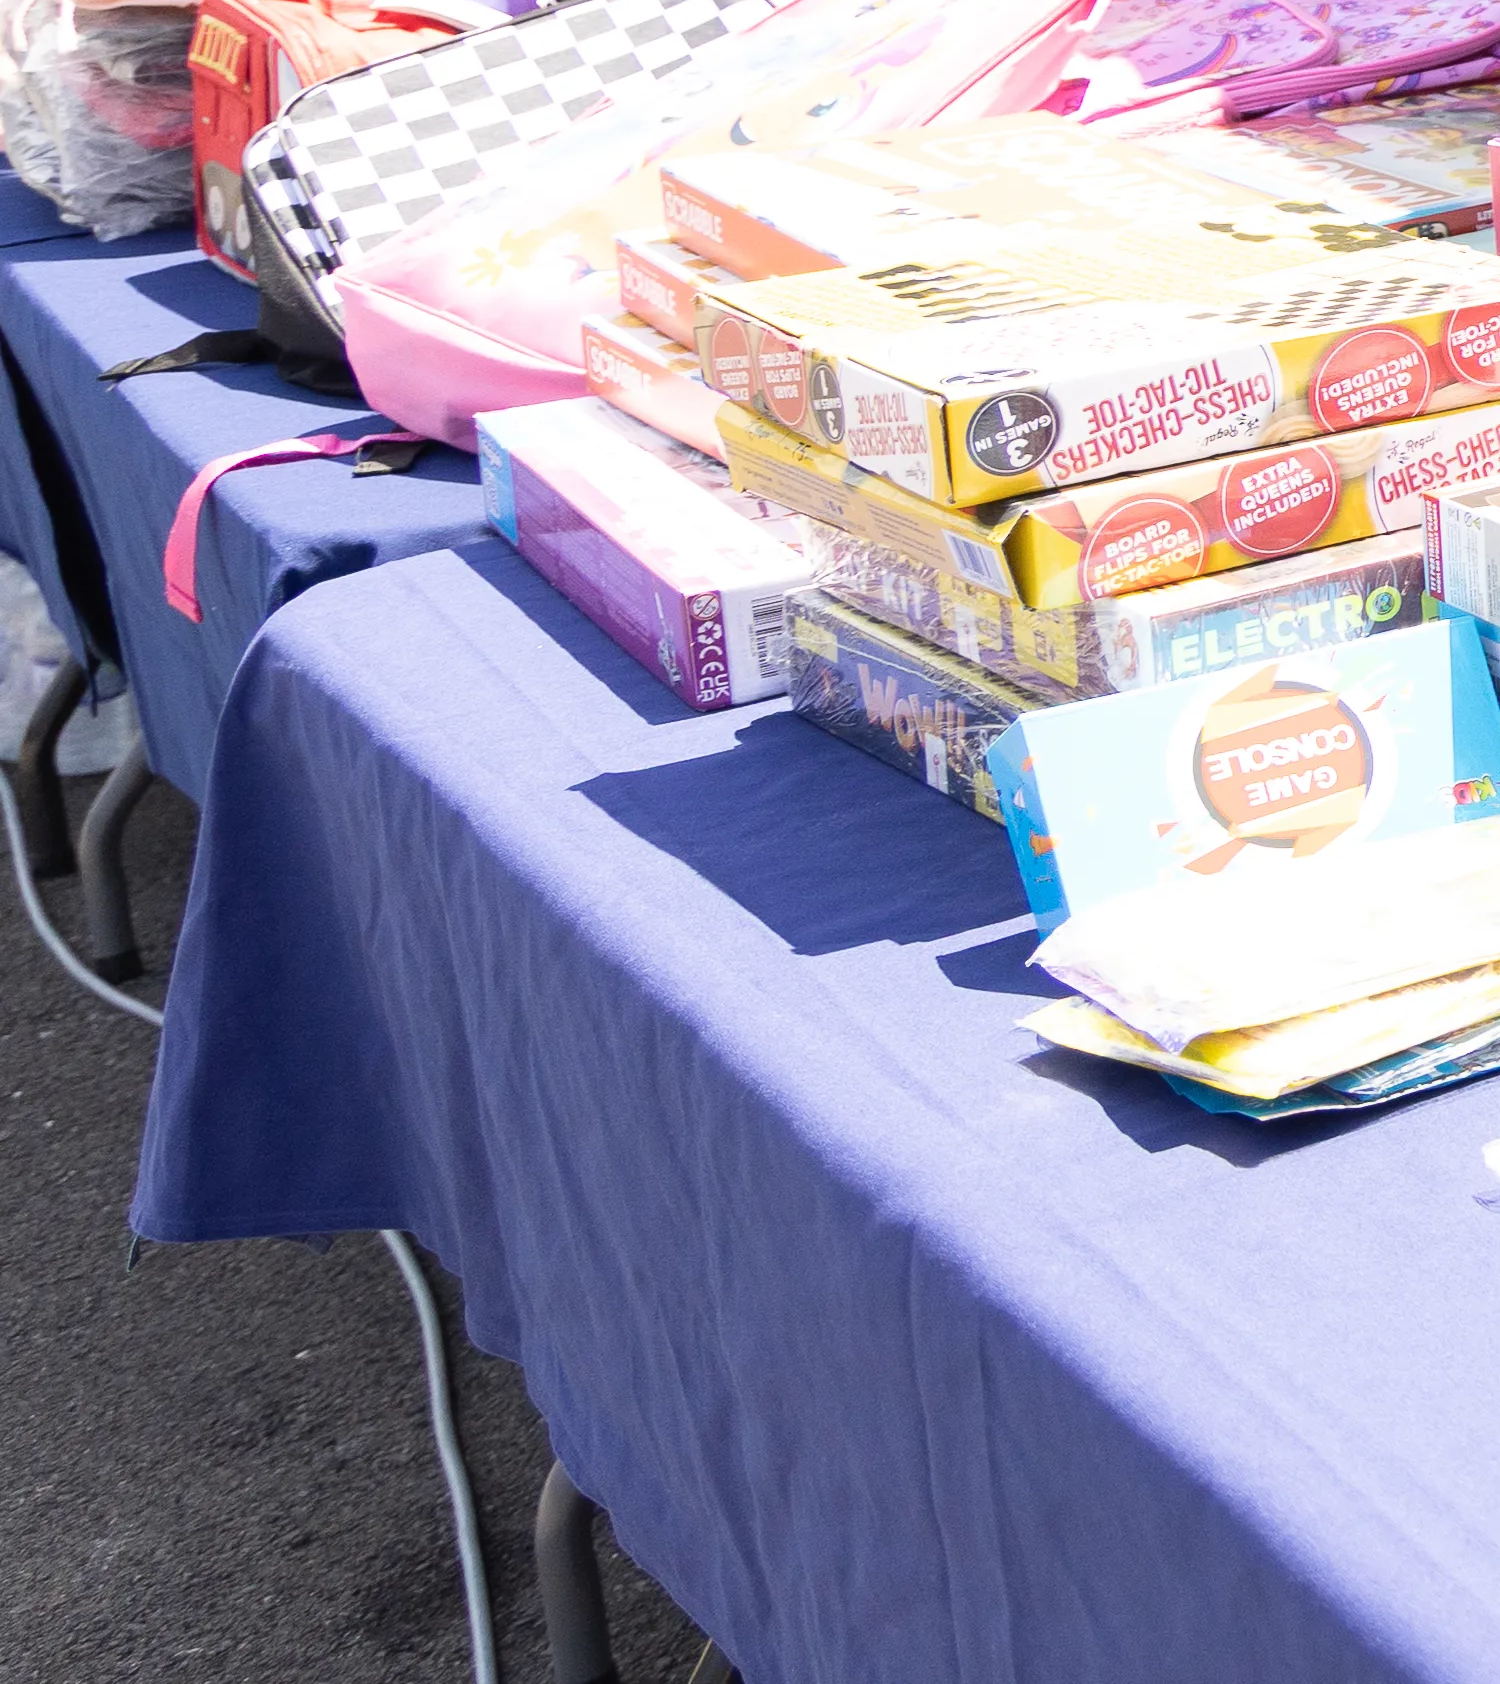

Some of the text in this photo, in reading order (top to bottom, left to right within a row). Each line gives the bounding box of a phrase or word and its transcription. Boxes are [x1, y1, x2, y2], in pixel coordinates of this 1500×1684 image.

[664, 190, 724, 244] SCRABBLE
[1460, 335, 1498, 359] FOR
[1082, 358, 1228, 436] TIC-TAC-TOE
[1322, 352, 1420, 402] INCLUDED!
[1338, 372, 1412, 411] QUEENS
[826, 411, 839, 439] 3
[999, 399, 1017, 424] 1
[1052, 372, 1272, 481] CHESS-CHECKERS
[1348, 390, 1409, 423] EXTRA
[974, 414, 1052, 454] GAMES IN
[1006, 438, 1031, 467] 3
[1240, 468, 1315, 512] QUEENS
[1241, 457, 1302, 494] EXTRA
[1232, 478, 1331, 533] INCLUDED!
[1093, 528, 1192, 581] FLIPS FOR
[1103, 520, 1171, 559] BOARD
[1170, 585, 1402, 678] ELECTRO
[1205, 723, 1357, 782] CONSOLE
[1244, 765, 1338, 807] GAME
